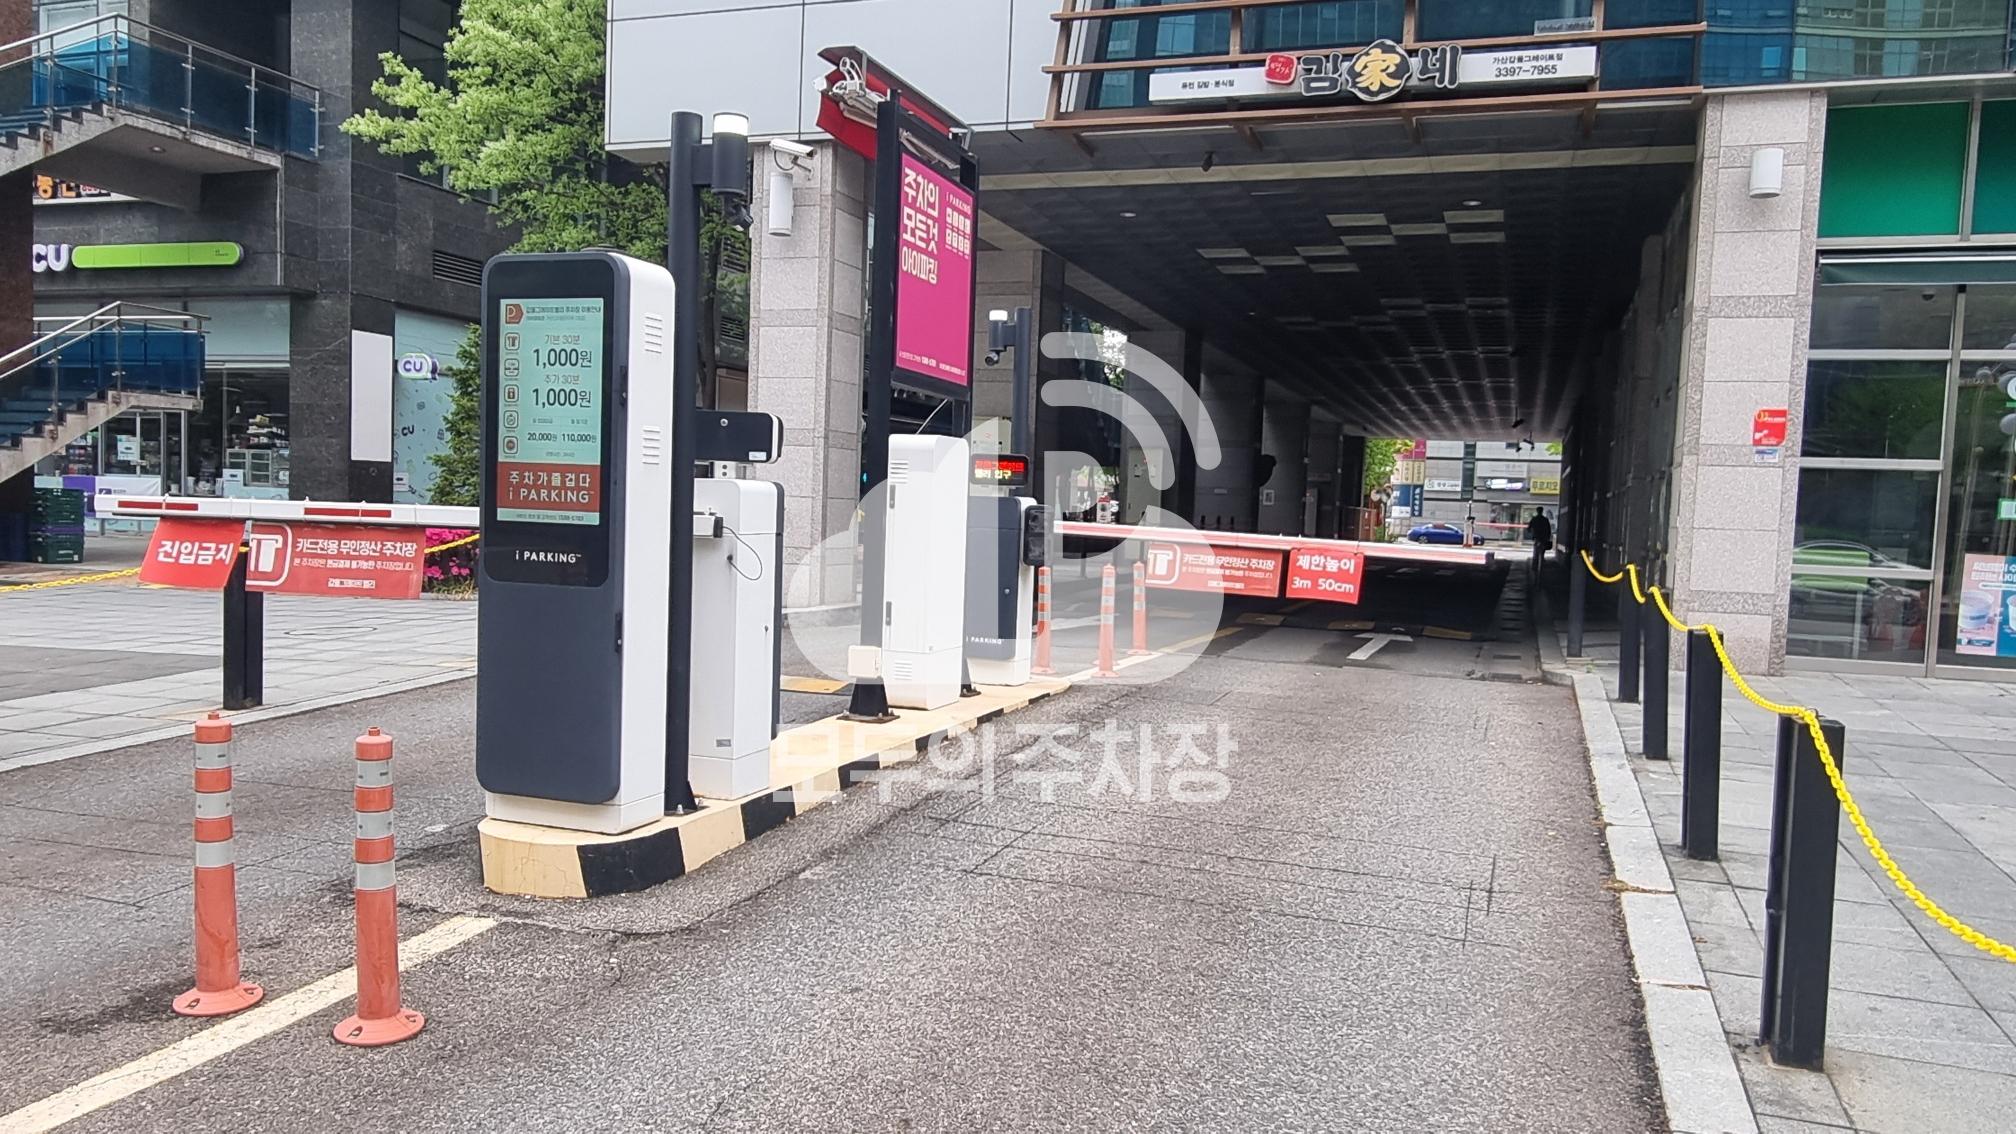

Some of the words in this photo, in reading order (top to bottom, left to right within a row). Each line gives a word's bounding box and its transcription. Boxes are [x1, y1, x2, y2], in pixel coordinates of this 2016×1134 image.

[1494, 64, 1558, 78] 3397-7955
[904, 166, 939, 218] 주차의
[950, 193, 971, 215] PARKING
[33, 243, 69, 273] CU
[902, 246, 938, 285] 아이파킹
[545, 334, 560, 346] 기본
[562, 334, 581, 346] 30분
[403, 360, 423, 372] CU
[533, 348, 592, 368] 1,000원
[561, 374, 581, 385] 30분
[532, 387, 592, 409] 1,000원
[401, 424, 415, 437] CU
[527, 432, 557, 442] 20,000원
[561, 433, 597, 444] 110,000원
[994, 469, 1012, 480] 입구
[520, 488, 590, 504] PARKING
[156, 539, 235, 566] 진입금지
[296, 538, 339, 555] 카드전용
[340, 539, 382, 556] 무인정산
[383, 541, 417, 558] 주차장
[524, 551, 577, 564] PARKING
[1250, 557, 1275, 571] 주차장
[1296, 554, 1355, 574] 제한높이
[1291, 577, 1312, 590] 3m
[1317, 578, 1354, 593] 50cm
